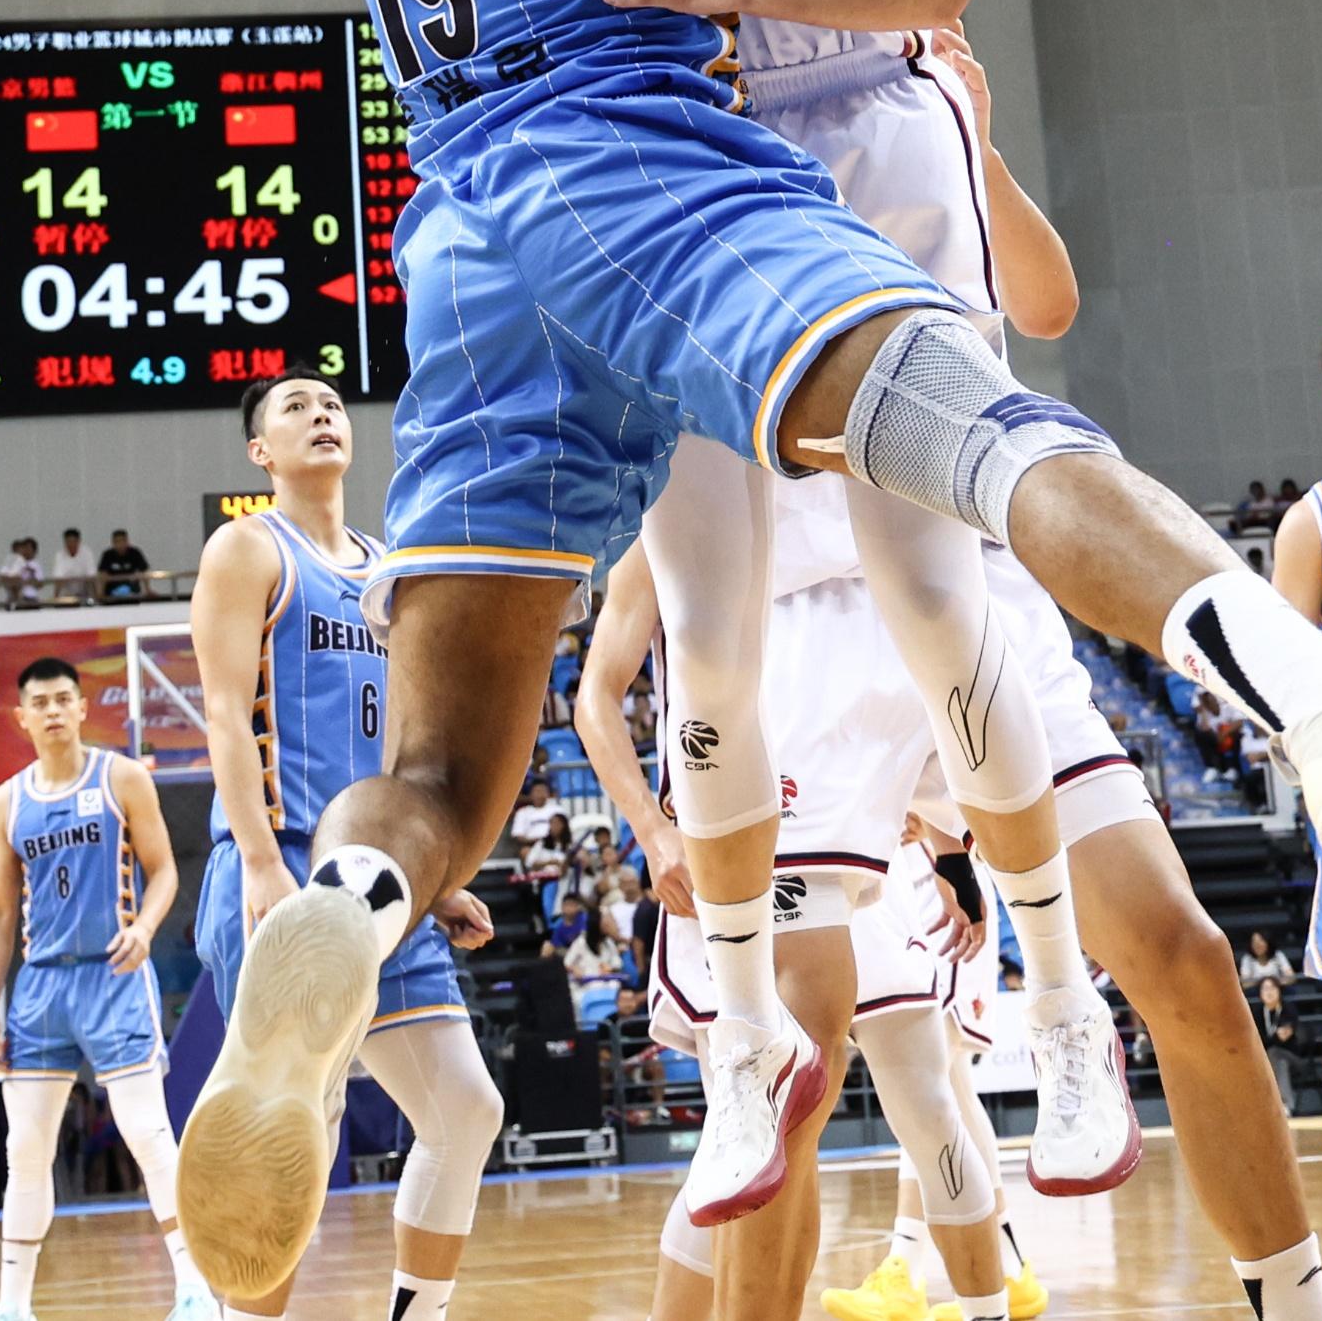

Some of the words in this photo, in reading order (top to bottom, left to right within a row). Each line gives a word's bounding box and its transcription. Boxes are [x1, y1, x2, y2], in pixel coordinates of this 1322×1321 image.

[120, 60, 175, 89] VS
[359, 72, 387, 91] 25
[100, 99, 200, 130] 第一节
[360, 100, 389, 118] 33
[362, 126, 390, 145] 53
[22, 167, 109, 219] 14
[216, 164, 302, 217] 14
[33, 221, 110, 256] 暂停
[202, 218, 278, 250] 暂停
[312, 214, 340, 245] 0
[21, 257, 290, 332] 04:45
[35, 354, 116, 387] 犯规
[130, 355, 186, 385] 4.9
[209, 348, 285, 380] 犯规
[319, 344, 345, 375] 3
[360, 680, 379, 739] 6
[684, 761, 719, 771] CBA
[780, 809, 797, 819] BA
[23, 821, 101, 862] BEIJING
[56, 865, 70, 900] 8
